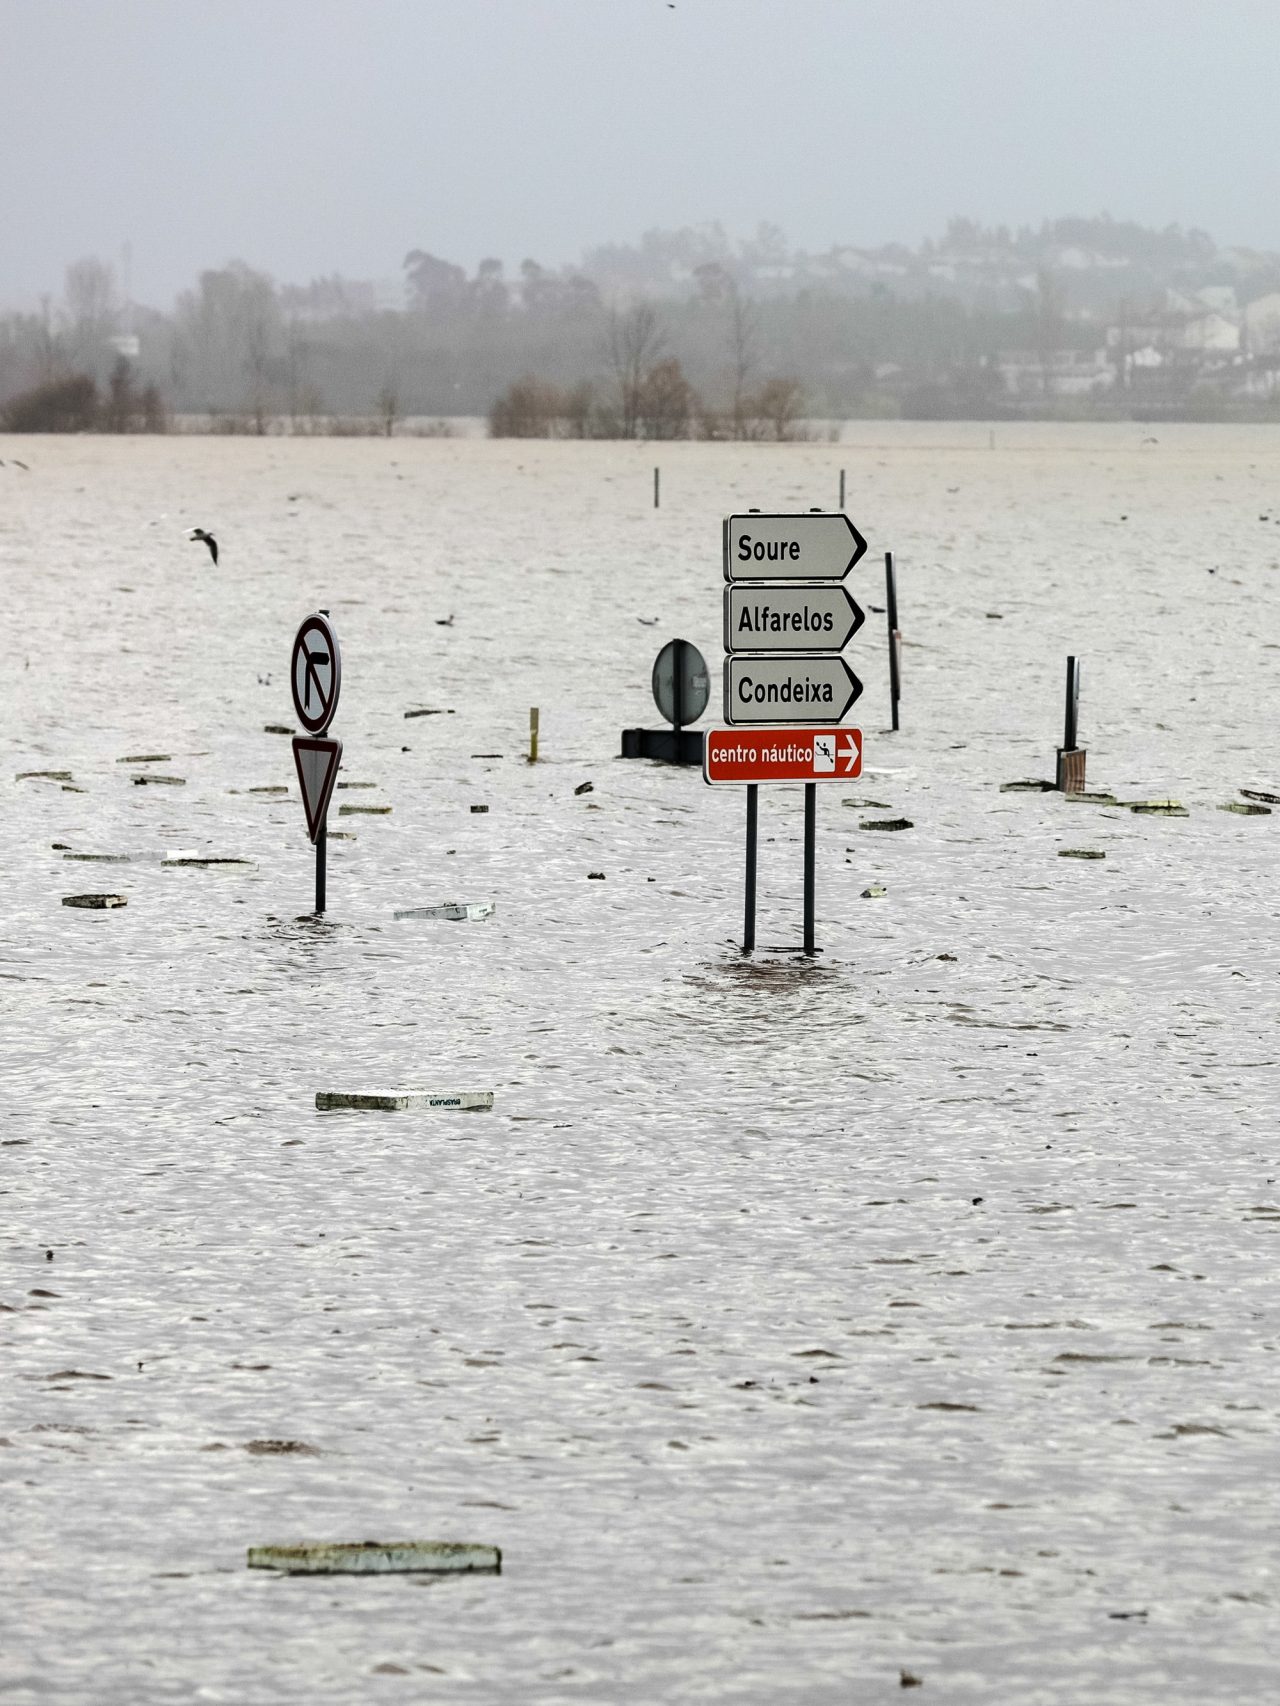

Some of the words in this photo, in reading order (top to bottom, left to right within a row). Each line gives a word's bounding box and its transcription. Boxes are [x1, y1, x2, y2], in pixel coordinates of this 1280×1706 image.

[737, 534, 800, 560] Soure
[738, 606, 833, 632] Alfarelos
[738, 676, 833, 703] Condeixa
[711, 744, 757, 763] centro
[761, 743, 813, 763] náutico
